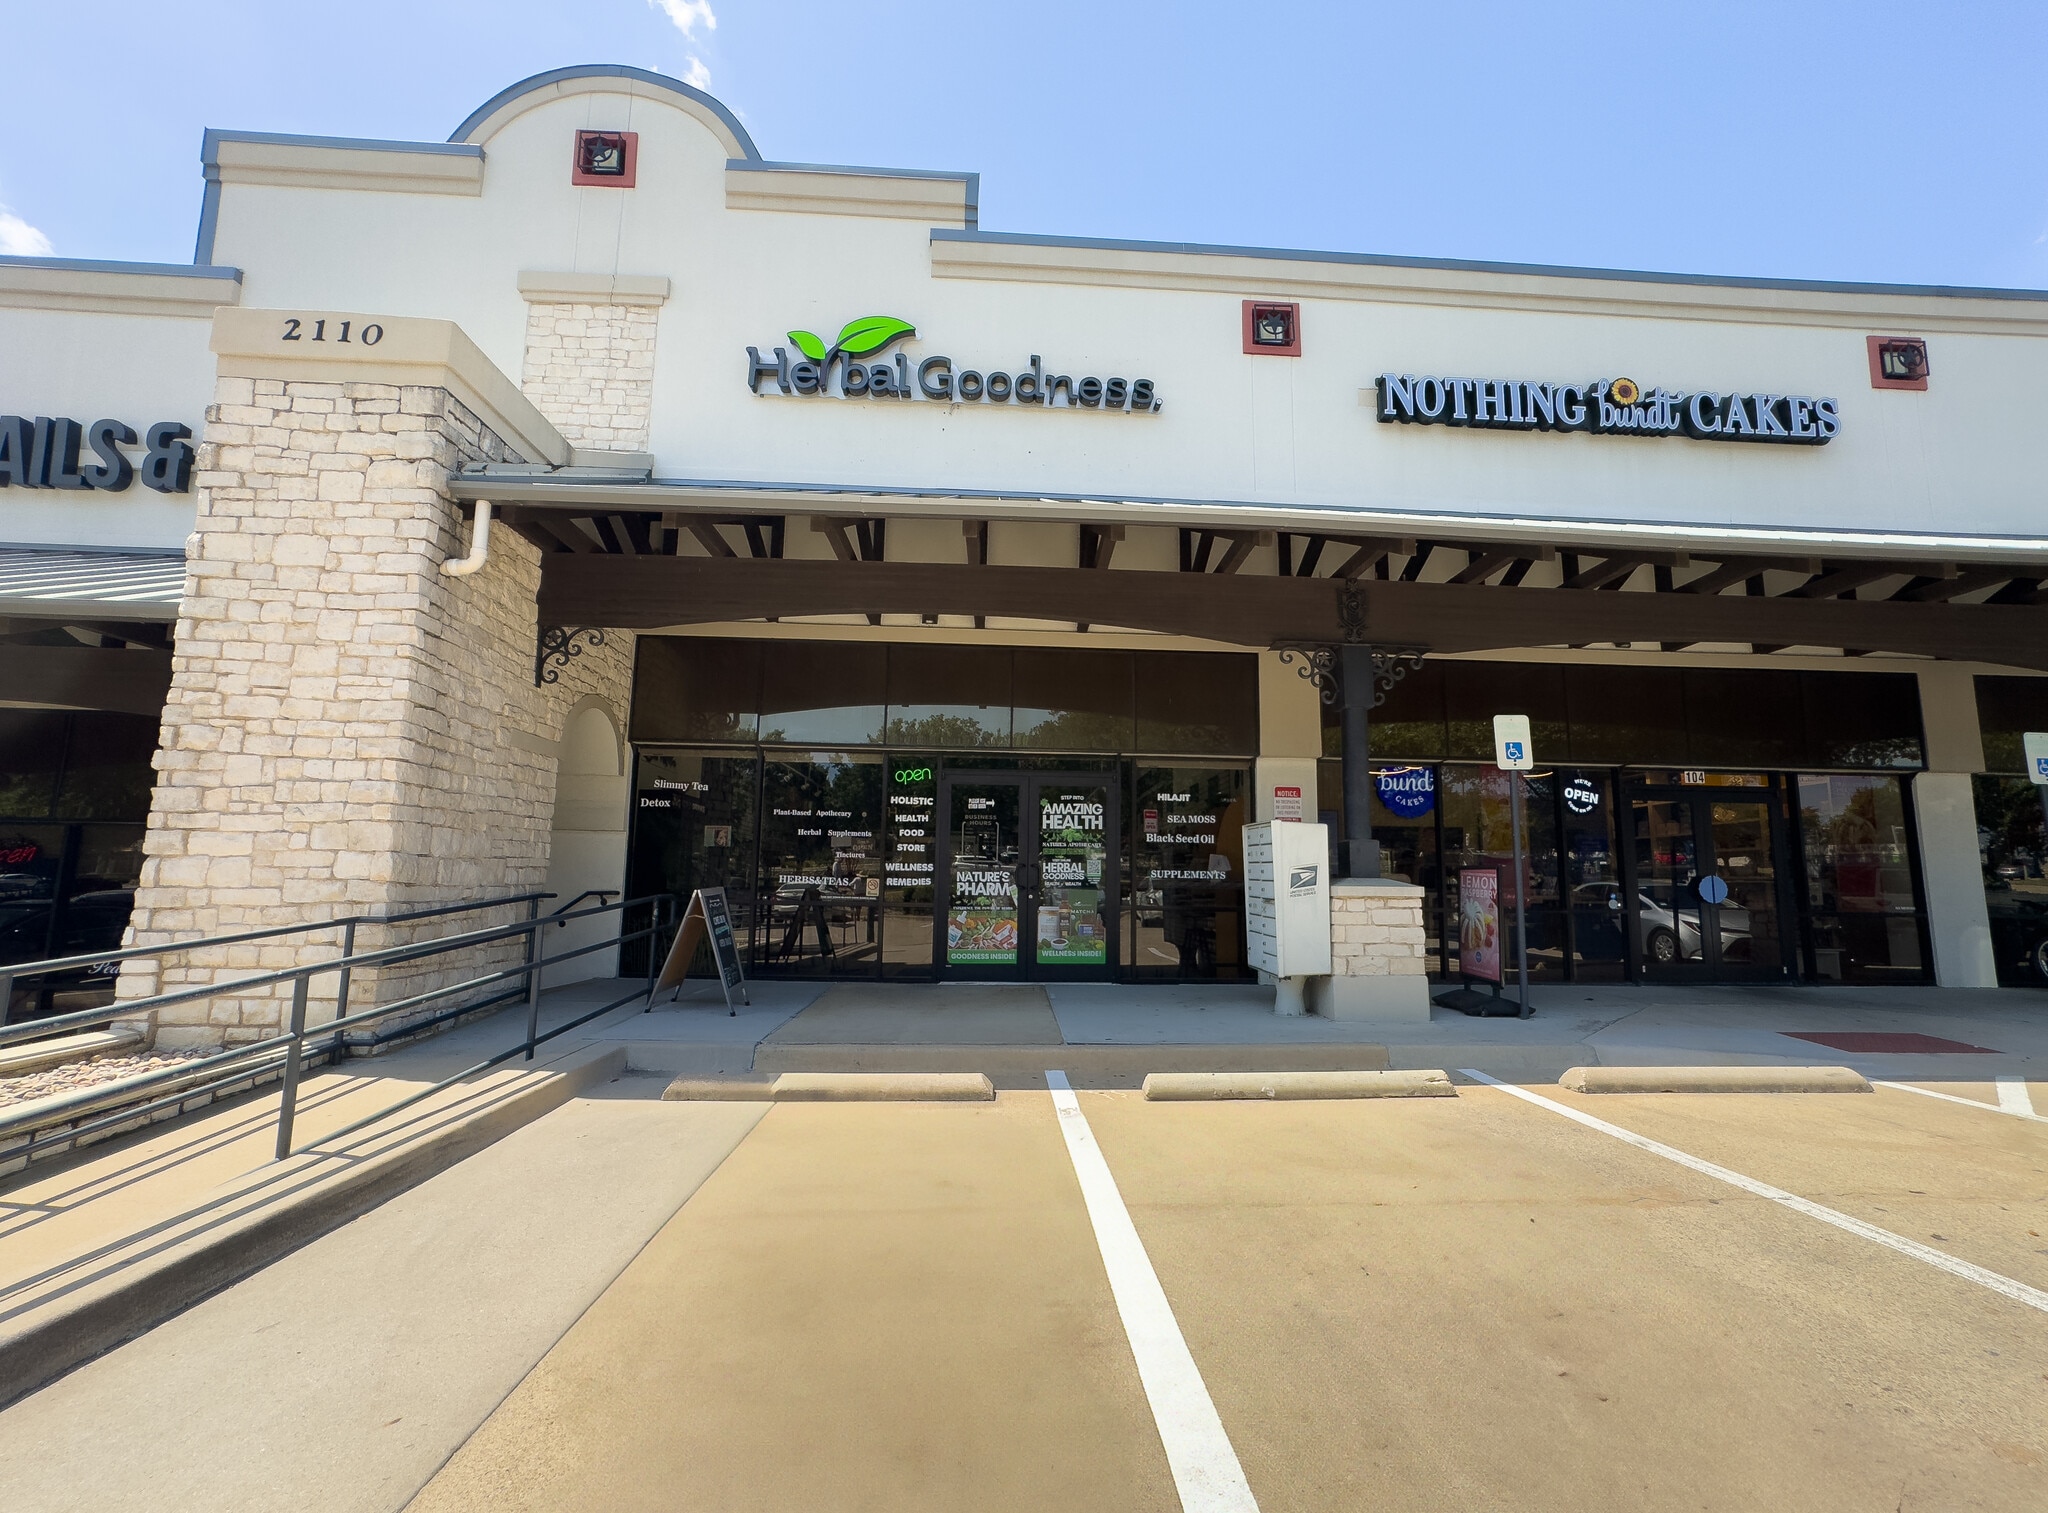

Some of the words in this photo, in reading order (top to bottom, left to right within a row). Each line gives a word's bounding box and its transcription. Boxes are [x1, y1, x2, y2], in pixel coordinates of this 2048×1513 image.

[282, 319, 385, 346] 2110
[746, 344, 910, 397] Herbal
[1379, 373, 1587, 426] NOTHING
[1593, 377, 1685, 432] bundt
[1689, 391, 1841, 440] CAKES
[0, 416, 138, 493] AILS
[141, 421, 196, 493] &
[895, 768, 932, 785] open
[1685, 772, 1705, 783] 104
[653, 779, 690, 792] Slimmy
[691, 781, 709, 791] Tea
[890, 796, 934, 805] HOLISTIC
[1157, 793, 1191, 802] HILAJIT
[1395, 795, 1425, 807] CAKES
[1564, 787, 1599, 804] OPEN
[640, 798, 671, 808] Detox
[773, 808, 812, 816] Plant-Based
[816, 809, 852, 818] Apothecary
[1042, 803, 1104, 815] AMAZING
[895, 814, 929, 822] HEALTH
[1042, 814, 1103, 830] HEALTH
[1167, 815, 1187, 823] SEA
[1188, 815, 1217, 824] MOSS
[797, 828, 822, 836] Herbal
[827, 829, 872, 838] Supplements
[899, 829, 925, 837] FOOD
[1146, 833, 1174, 843] Black
[1175, 834, 1200, 844] Seed
[1200, 834, 1215, 844] Oil
[896, 844, 926, 852] STORE
[835, 851, 866, 859] Tinctures
[885, 863, 934, 871] WELLNESS
[1042, 862, 1085, 873] HERBAL
[778, 874, 850, 886] HERBS&TEAS
[956, 870, 1011, 882] NATURE'S
[1042, 872, 1085, 880] GOODNESS
[1150, 869, 1226, 880] SUPPLEMENTS
[886, 878, 931, 886] REMEDIES
[1461, 876, 1497, 889] LEMON
[956, 882, 1011, 896] PHARM
[1461, 888, 1497, 899] RASPBERRY
